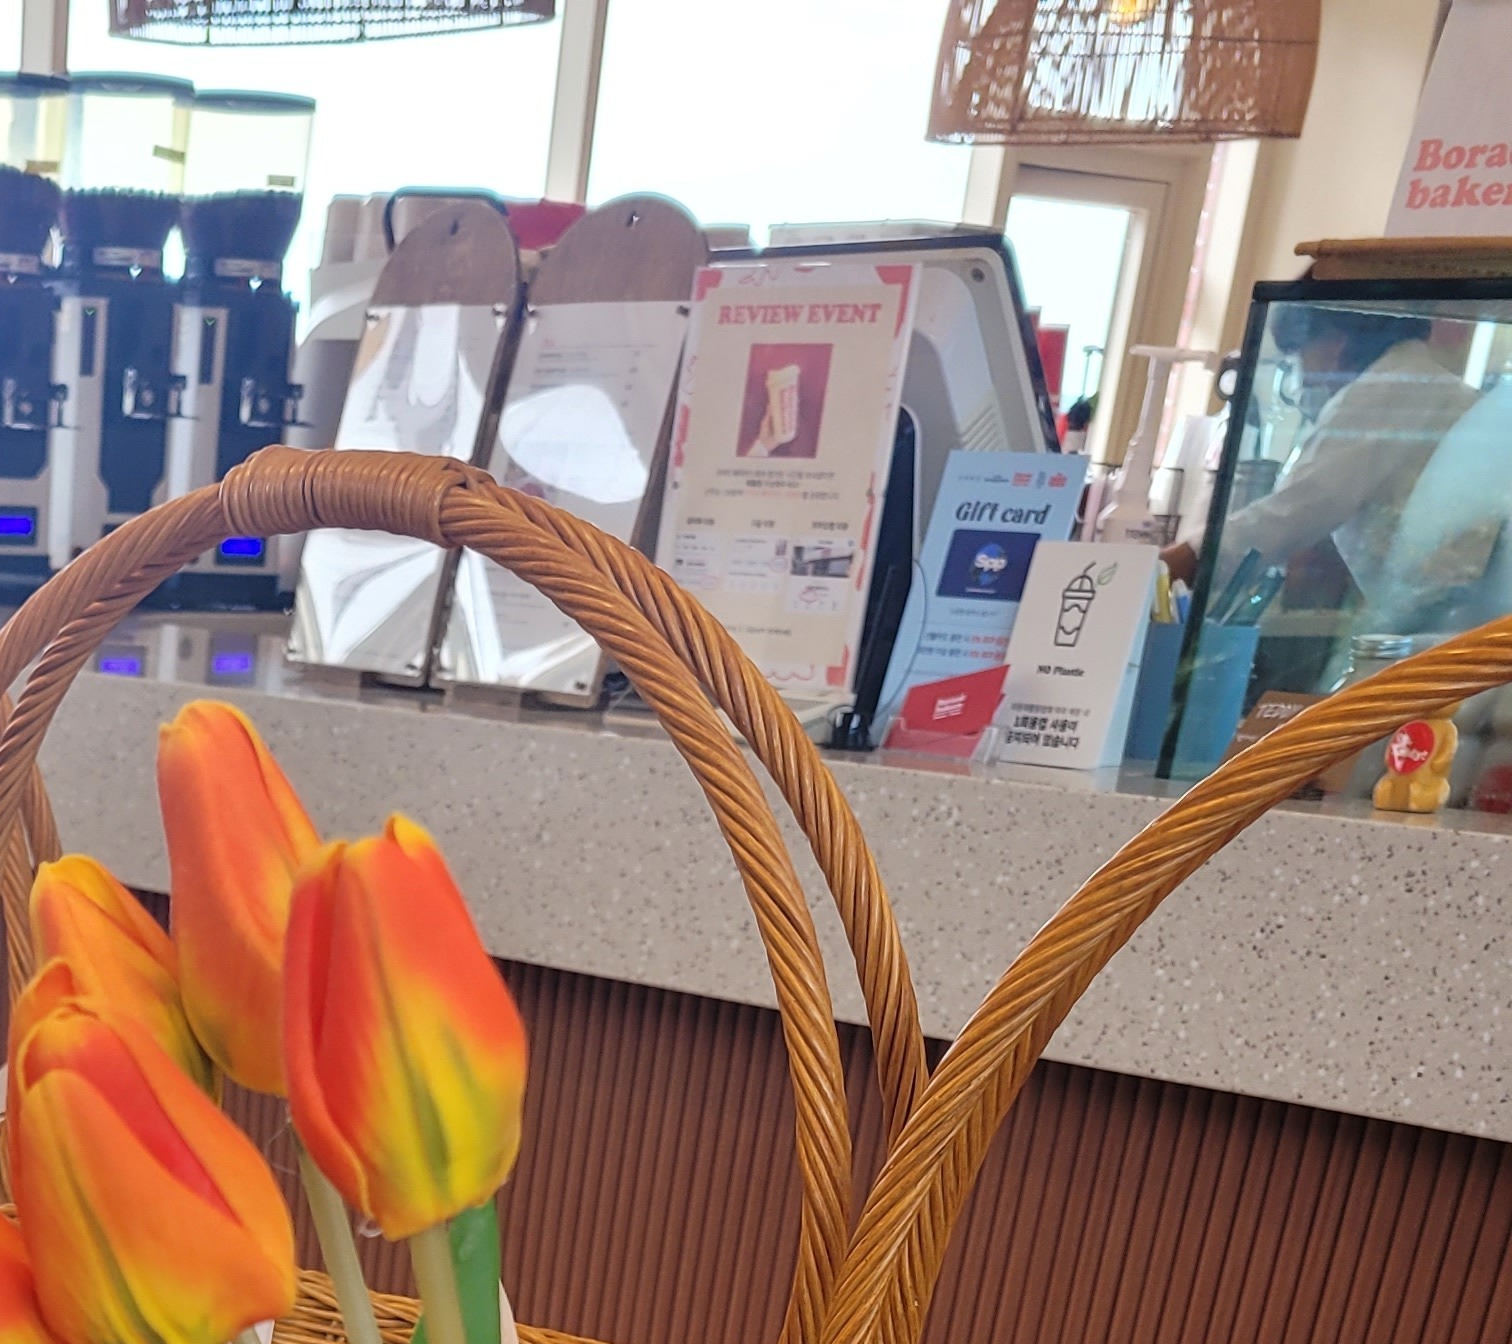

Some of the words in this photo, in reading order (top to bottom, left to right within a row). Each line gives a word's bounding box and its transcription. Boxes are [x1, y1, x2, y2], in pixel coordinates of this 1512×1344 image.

[1412, 138, 1512, 172] Bora
[718, 304, 805, 325] REVIEW
[806, 303, 882, 323] EVENT
[955, 501, 999, 522] Gift
[1000, 503, 1053, 525] card
